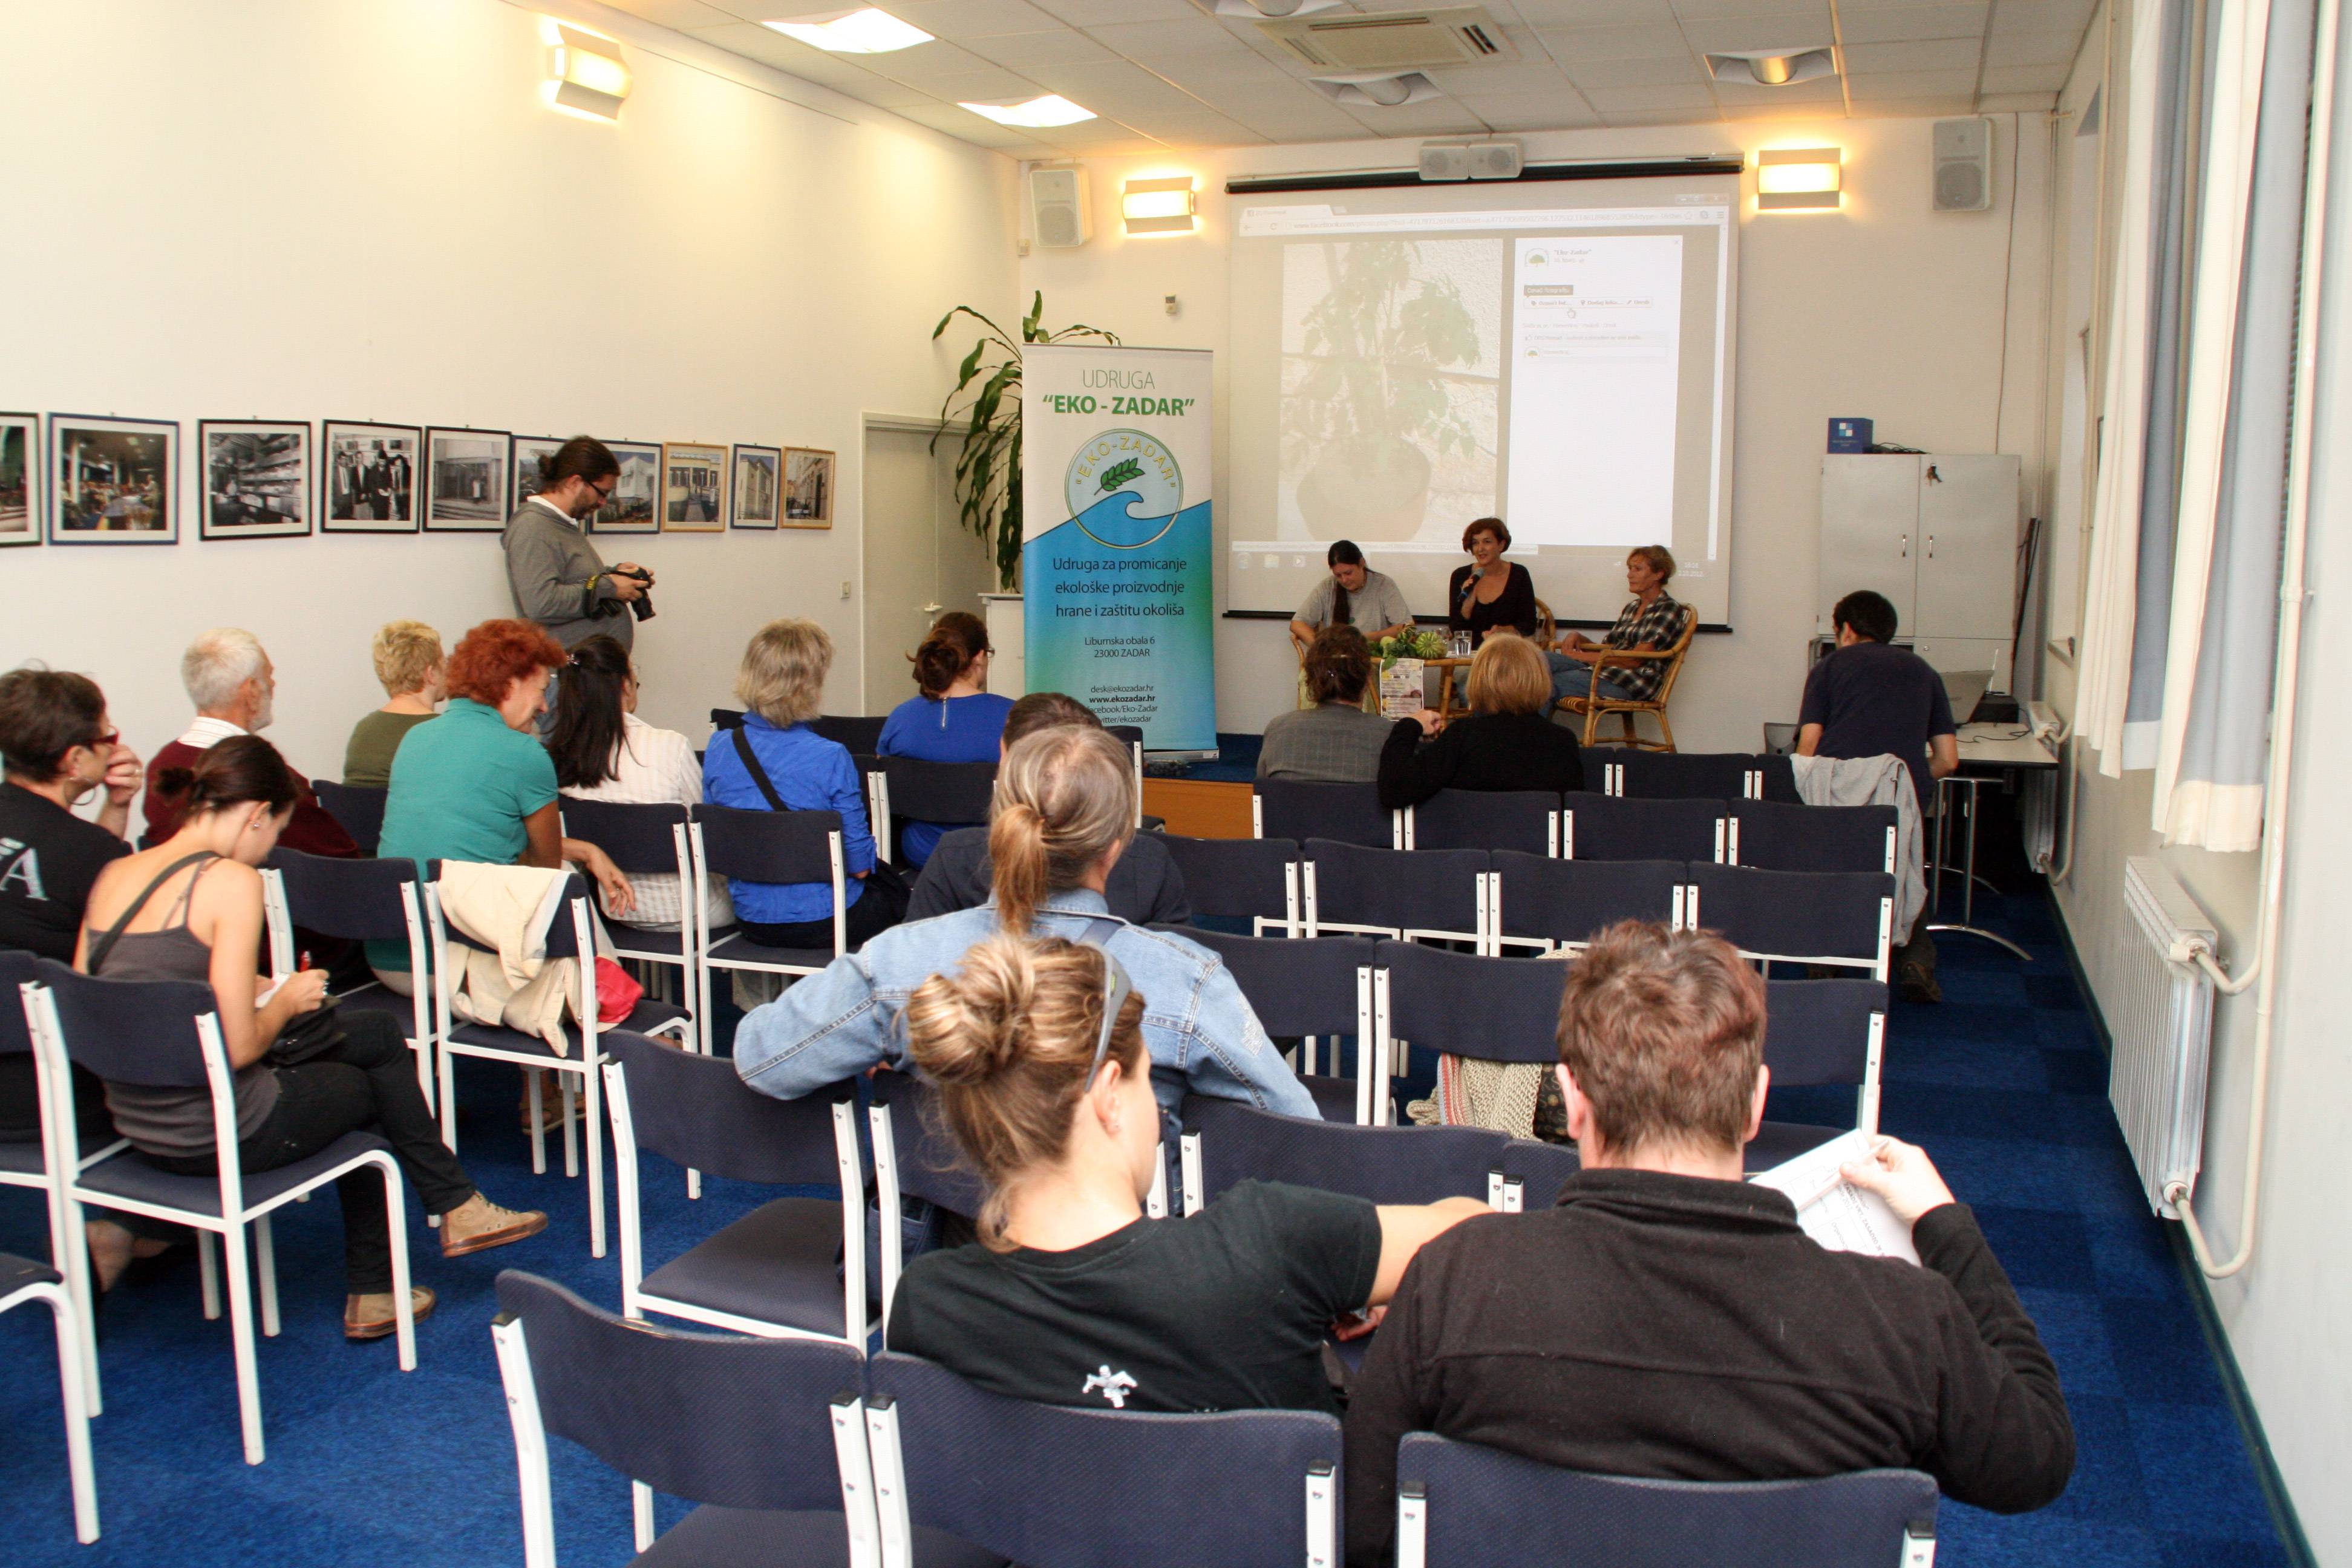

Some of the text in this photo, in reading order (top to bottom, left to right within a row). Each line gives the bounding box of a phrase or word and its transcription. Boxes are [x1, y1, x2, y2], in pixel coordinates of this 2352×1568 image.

[1082, 369, 1155, 390] UDRUGA
[1053, 557, 1187, 573] Udruga za promicanje
[1055, 581, 1184, 596] ekološke proizvodnje
[1056, 603, 1184, 616] hrane i zaštitu okoliša
[1085, 636, 1124, 645] Liburnska
[1126, 636, 1148, 645] obala
[1094, 648, 1150, 658] 23000 ZADAR
[1091, 684, 1154, 694] desk@ekozadar.hr
[1089, 694, 1156, 703] www.ekozadar.hr
[1088, 704, 1158, 714] acebook/Eko-Zadar
